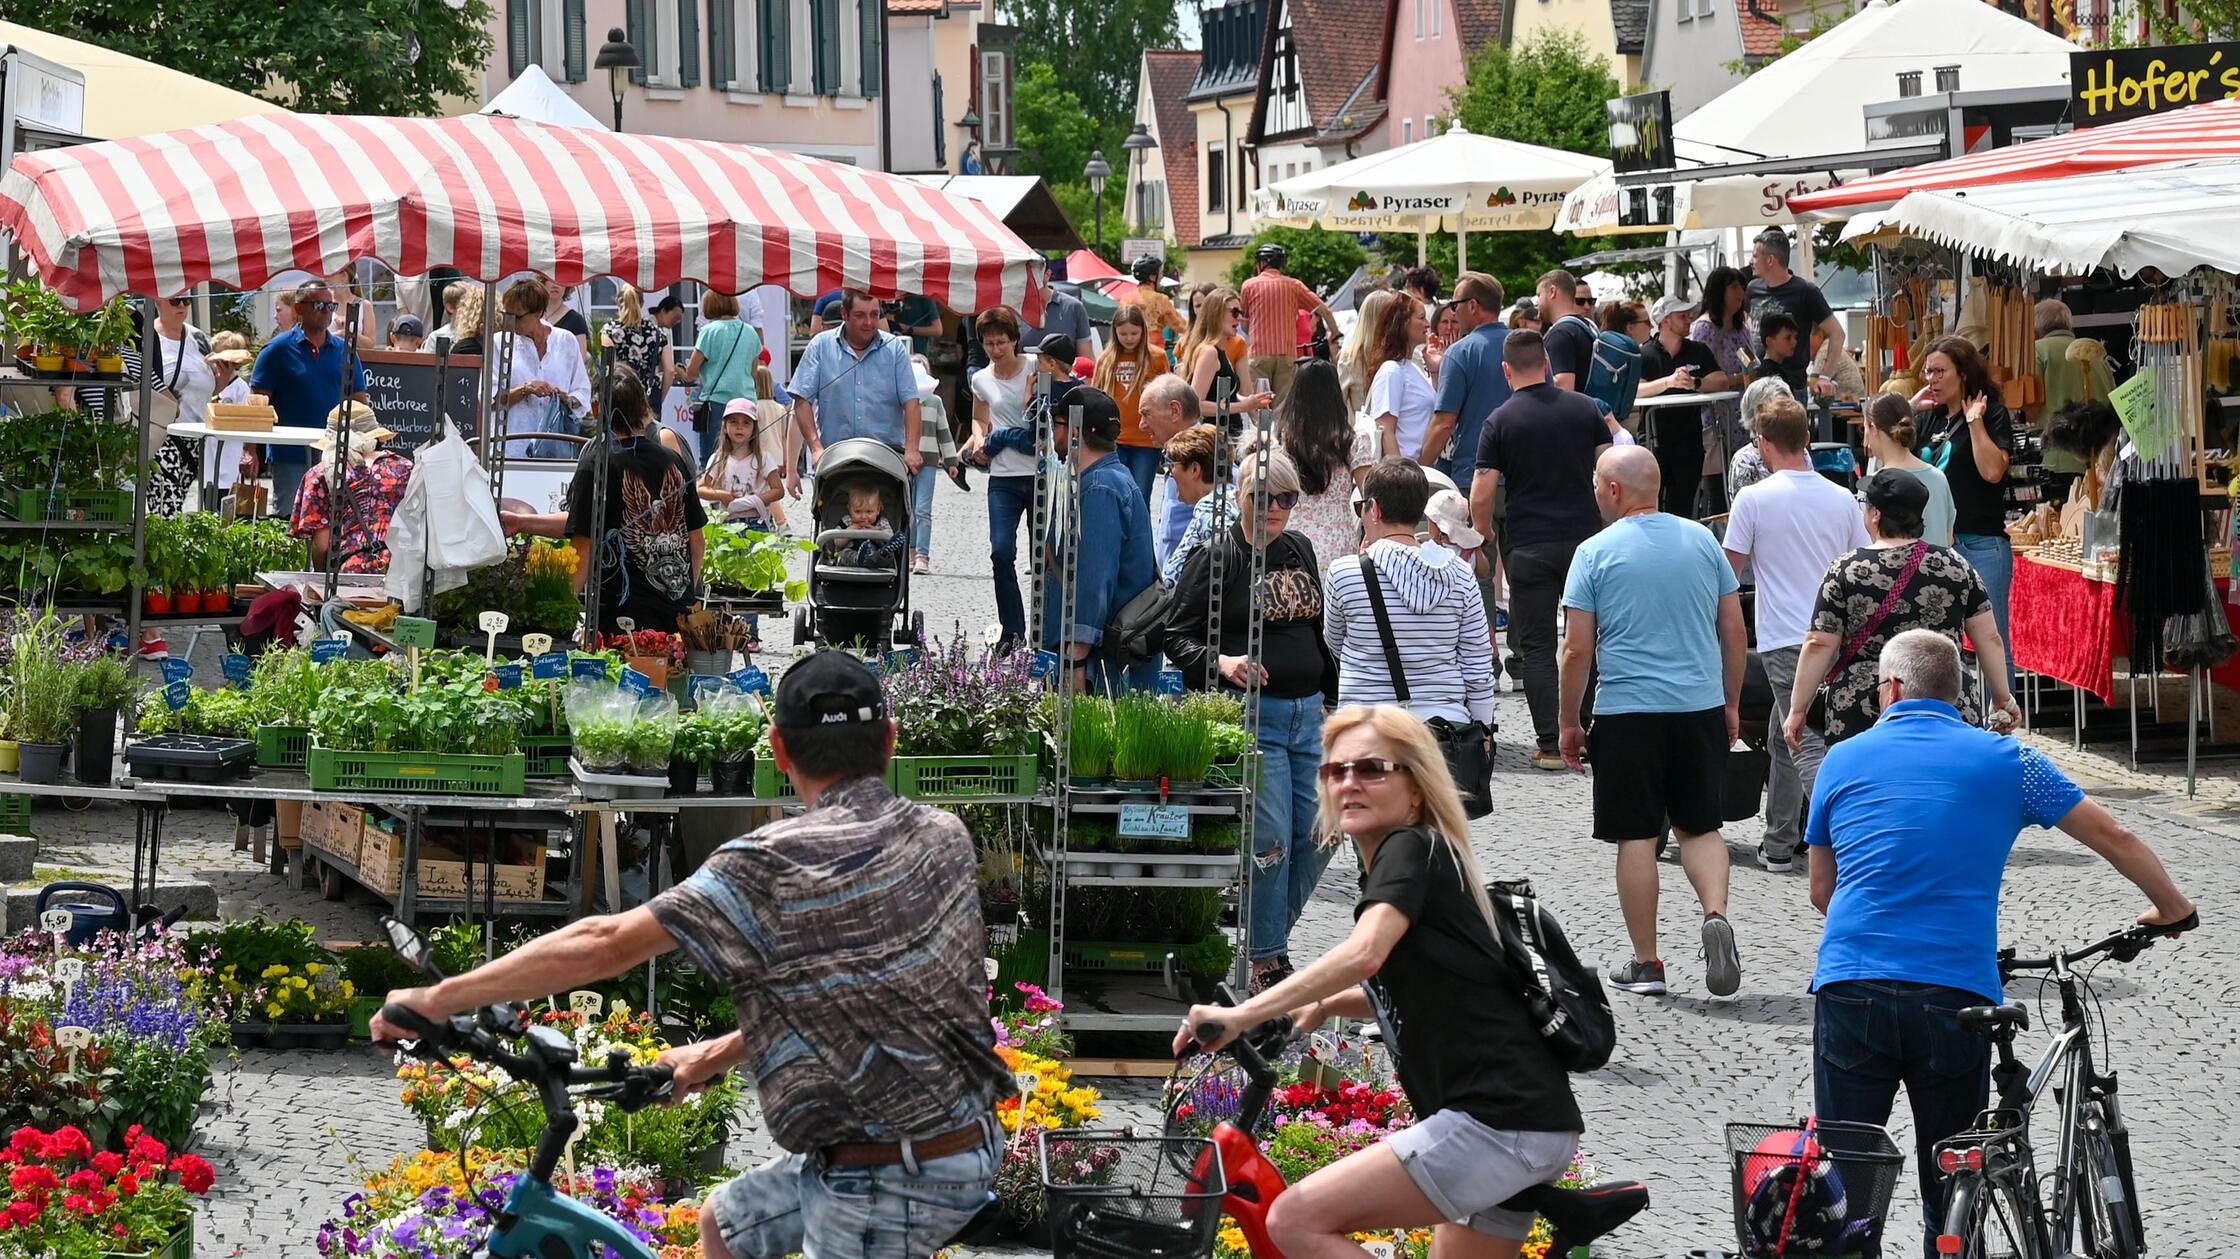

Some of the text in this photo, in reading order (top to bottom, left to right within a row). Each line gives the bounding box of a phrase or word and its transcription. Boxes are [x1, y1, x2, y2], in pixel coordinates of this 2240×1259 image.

[1287, 198, 1320, 215] Pyraser
[1383, 196, 1453, 213] Pyraser
[1522, 191, 1568, 208] Pyras
[363, 368, 402, 389] Breze
[821, 712, 848, 724] Audi
[45, 913, 67, 928] 4,50
[60, 962, 78, 978] 3,90
[573, 995, 597, 1011] 3,90
